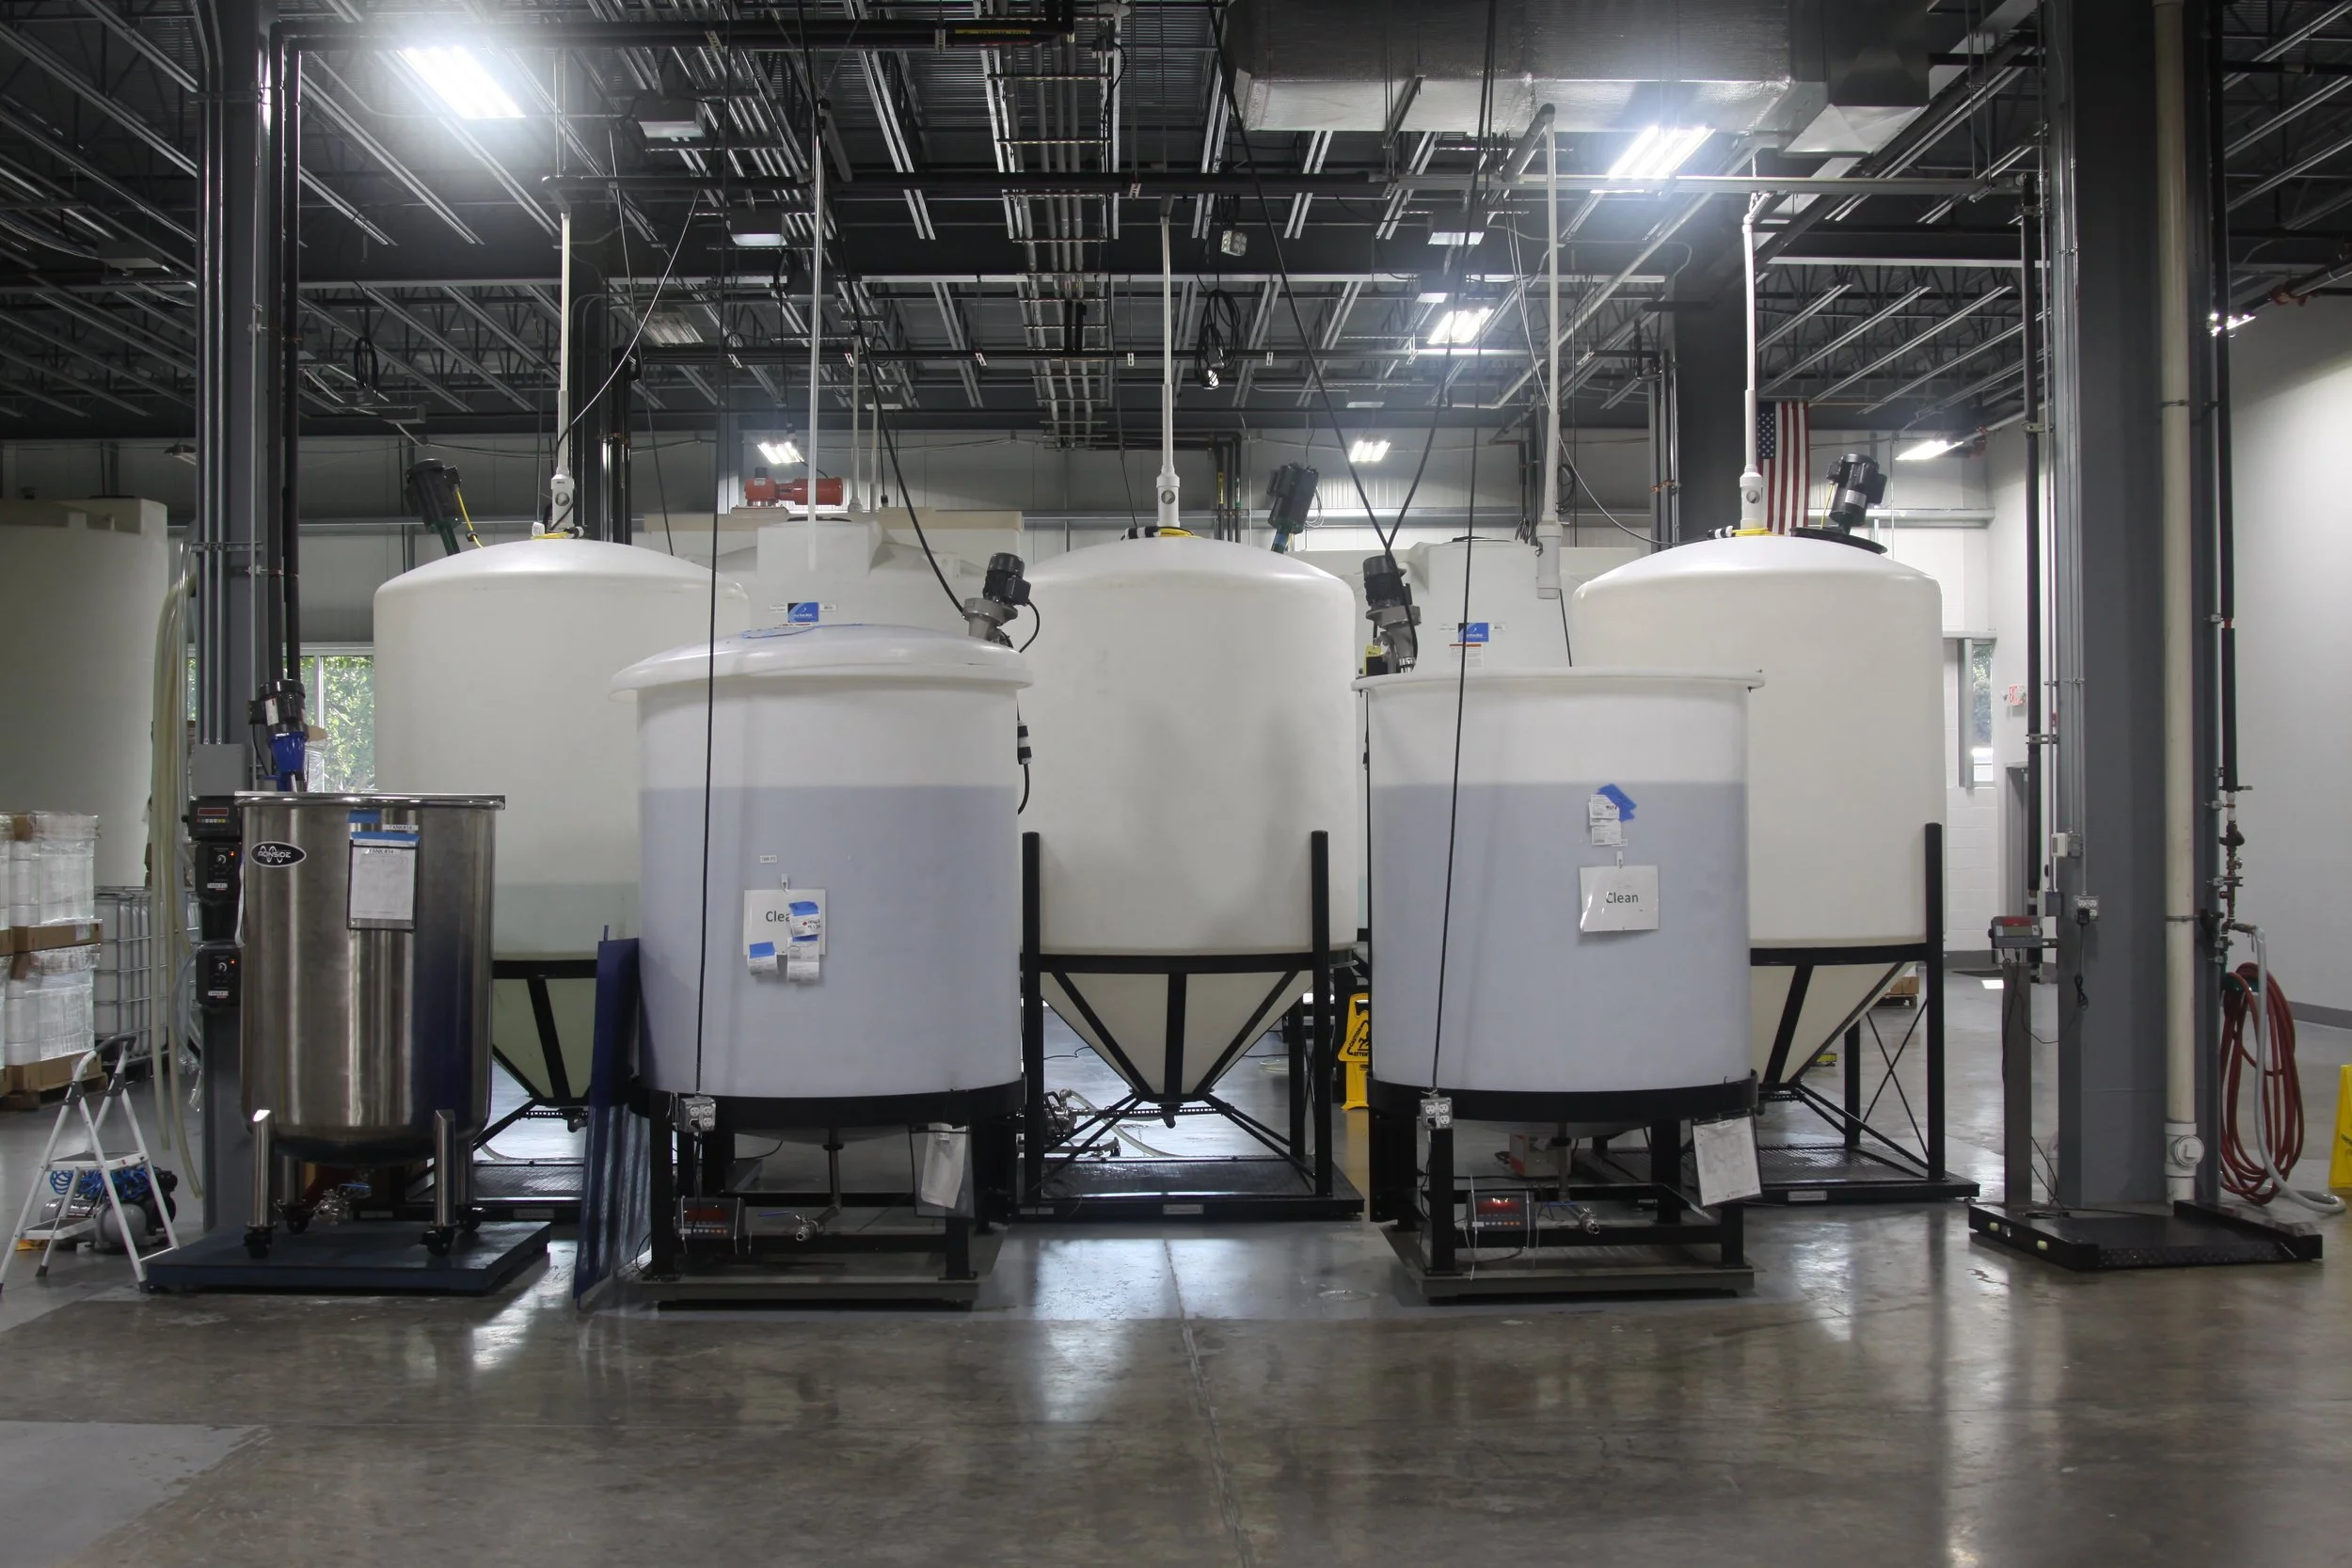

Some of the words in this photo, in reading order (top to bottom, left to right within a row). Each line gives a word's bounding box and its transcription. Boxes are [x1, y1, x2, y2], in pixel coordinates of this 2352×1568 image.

[1606, 892, 1639, 904] Clean
[766, 910, 790, 923] Clea
[1348, 1027, 1362, 1047] CAUTION
